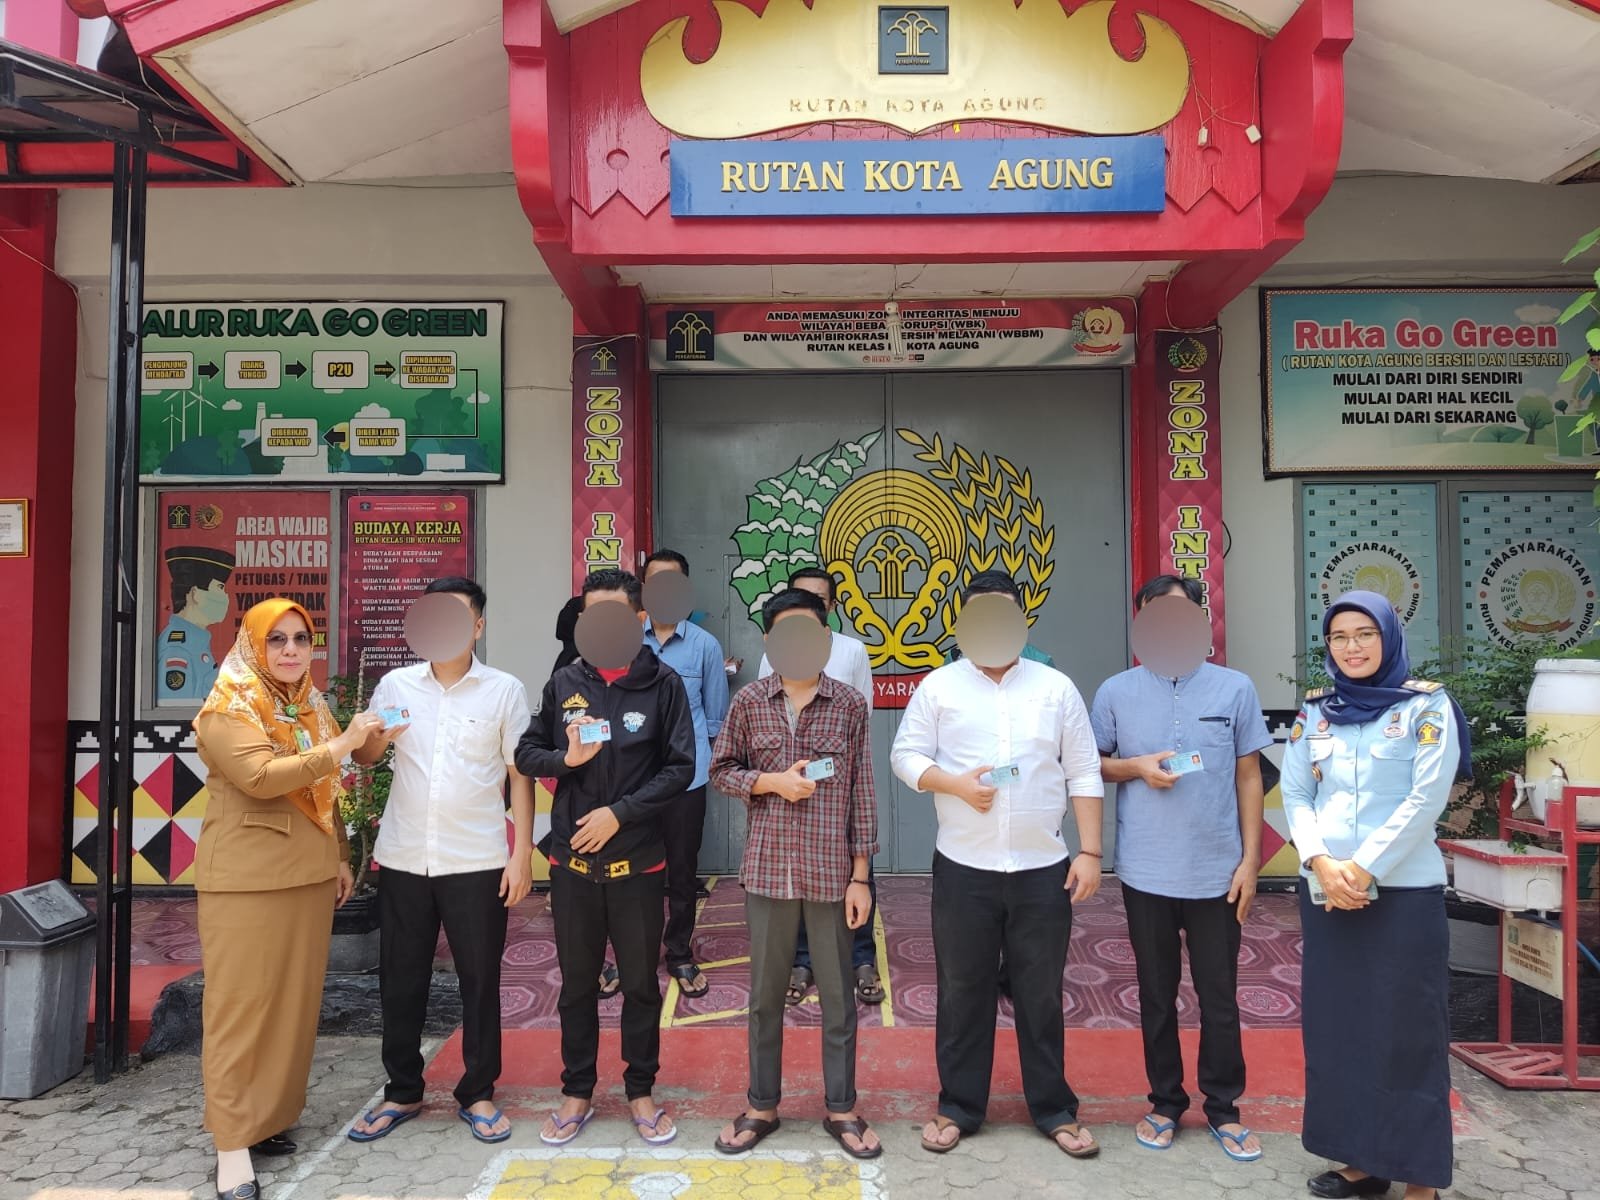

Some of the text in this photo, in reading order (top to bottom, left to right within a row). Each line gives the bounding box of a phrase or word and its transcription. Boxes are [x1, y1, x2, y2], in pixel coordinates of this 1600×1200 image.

[721, 157, 1114, 192] RUTAN KOTA AGUNG
[142, 307, 487, 337] ALUR RUKA GO GREEN
[767, 308, 1019, 321] ANDA MEMASUKI ZON INTEGRITAS MENUJU
[801, 322, 852, 331] WILAYAH
[856, 322, 886, 330] BEBA
[950, 320, 986, 330] (WBK)
[743, 329, 1044, 342] DAN WILAYAH BIROKRASI ERSIH MELAYANI (WBBM)
[1294, 318, 1557, 350] Ruka Go Green
[807, 343, 845, 352] RUTAN
[848, 343, 885, 351] KELAS
[906, 341, 980, 351] KOTA AGUNG
[1338, 355, 1375, 368] KOTA
[1376, 354, 1423, 368] AGUNG
[1425, 354, 1475, 367] BERSIH
[1478, 354, 1507, 367] DAN
[328, 362, 353, 377] P2U
[1333, 371, 1523, 386] MULAI DARI DIRI SENDIRI
[1343, 391, 1514, 405] MULAI DARI HAL KECIL
[1341, 410, 1517, 425] MULAI DARI SEKARANG
[584, 387, 622, 487] ZONA
[1168, 380, 1208, 481] ZONA
[235, 516, 328, 535] AREA WAJIB
[354, 521, 462, 535] BUDAYA KERJA
[355, 536, 379, 544] RUTAN
[381, 536, 404, 544] KELAS
[417, 536, 435, 544] KOTA
[437, 536, 461, 544] AGUNG
[235, 540, 328, 567] MASKER
[1322, 542, 1418, 580] PEMASYARAKATAN
[1481, 542, 1592, 586] PEMASYARAKATAN
[235, 573, 286, 586] PETUGAS
[297, 573, 327, 585] TAMU
[1480, 603, 1500, 637] RUTAN
[1577, 602, 1595, 639] AGUNG
